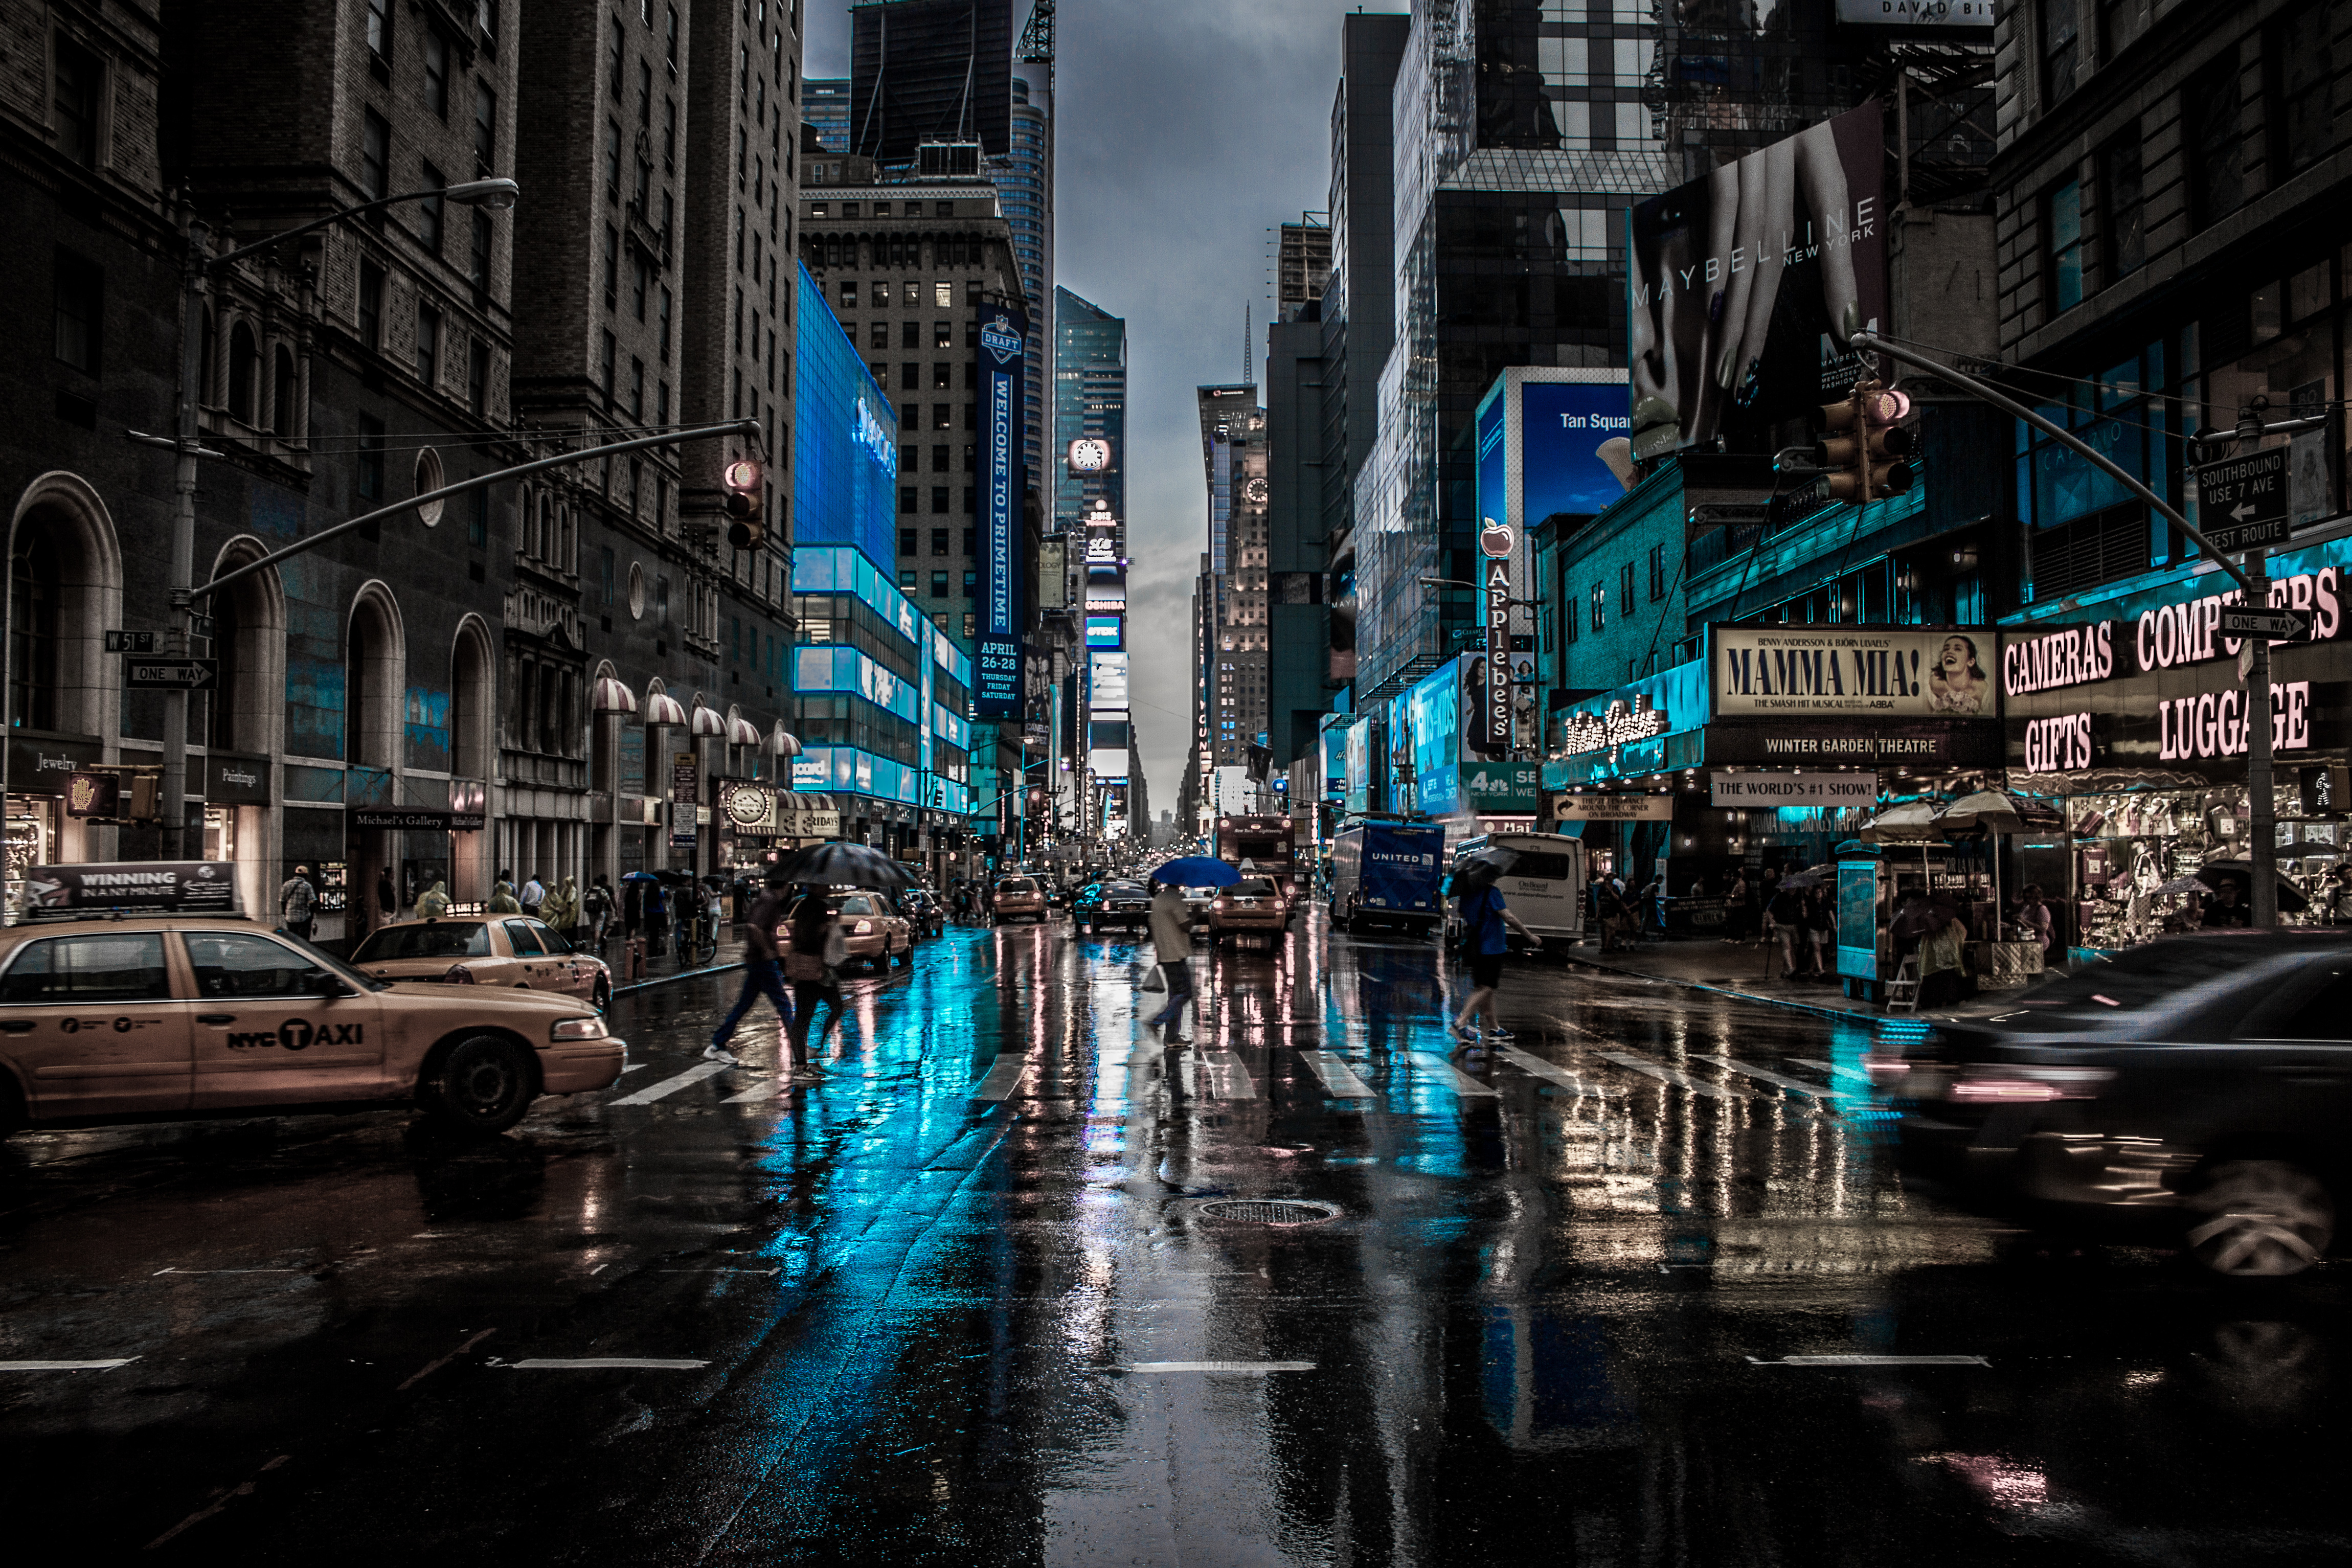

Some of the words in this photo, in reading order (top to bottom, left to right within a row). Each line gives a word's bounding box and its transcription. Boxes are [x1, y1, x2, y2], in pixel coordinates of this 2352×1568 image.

[1883, 1, 1946, 13] DAVID
[1632, 196, 1875, 307] MAYBELLINE
[1783, 245, 1818, 267] NEW
[1826, 224, 1874, 251] YORK
[985, 333, 1018, 349] DRAFT
[1822, 377, 1853, 390] FASHION
[994, 380, 1007, 475] WELCOME
[1561, 413, 1586, 428] Tan
[2202, 455, 2280, 487] SOUTHBOUND
[994, 481, 1006, 507] TO
[2209, 486, 2231, 504] USE
[2238, 484, 2244, 497] 7
[2252, 476, 2274, 494] AVE
[2207, 532, 2235, 549] BEST
[2242, 522, 2280, 543] ROUTE
[994, 512, 1006, 627] PRIMETIME
[2137, 566, 2340, 672] COMPUERS
[2232, 616, 2257, 628] ONE
[2270, 619, 2296, 631] WAY
[109, 633, 119, 649] W
[123, 633, 134, 650] 51
[140, 634, 150, 642] ST
[981, 642, 1016, 655] APRIL
[1783, 638, 1825, 647] ANDERSSON
[1488, 565, 1510, 736] Applebee's
[2004, 620, 2112, 696] CAMERAS
[982, 656, 1016, 670] 26-28
[140, 668, 165, 679] ONE
[177, 668, 203, 680] WAY
[982, 673, 1016, 681] THURSDAY
[1727, 648, 1844, 696] MAMMA
[1852, 649, 1920, 697] MIA!
[982, 691, 1015, 700] SATURDAY
[1754, 699, 1769, 708] THE
[1770, 699, 1796, 708] SMASH
[1798, 699, 1810, 708] HIT
[1812, 700, 1844, 708] MUSICAL
[1033, 735, 1047, 745] OPEZ
[1765, 738, 1818, 754] WINTER
[1821, 738, 1873, 754] GARDEN
[1878, 739, 1936, 754] THEATRE
[2025, 713, 2091, 773] GIFTS
[36, 753, 77, 772] Jewelry
[223, 768, 256, 786] Paintings
[1471, 771, 1489, 791] 4
[1718, 782, 1743, 795] THE
[1747, 783, 1805, 796] WORLD'S
[1810, 783, 1823, 796] #1
[1828, 783, 1871, 796] SHOW!
[357, 815, 403, 825] Michael's
[406, 816, 443, 828] Gallery
[1372, 853, 1419, 862] UNITED
[80, 872, 177, 885] WINNING
[227, 1032, 277, 1049] NYC
[279, 1018, 364, 1051] TAXI
